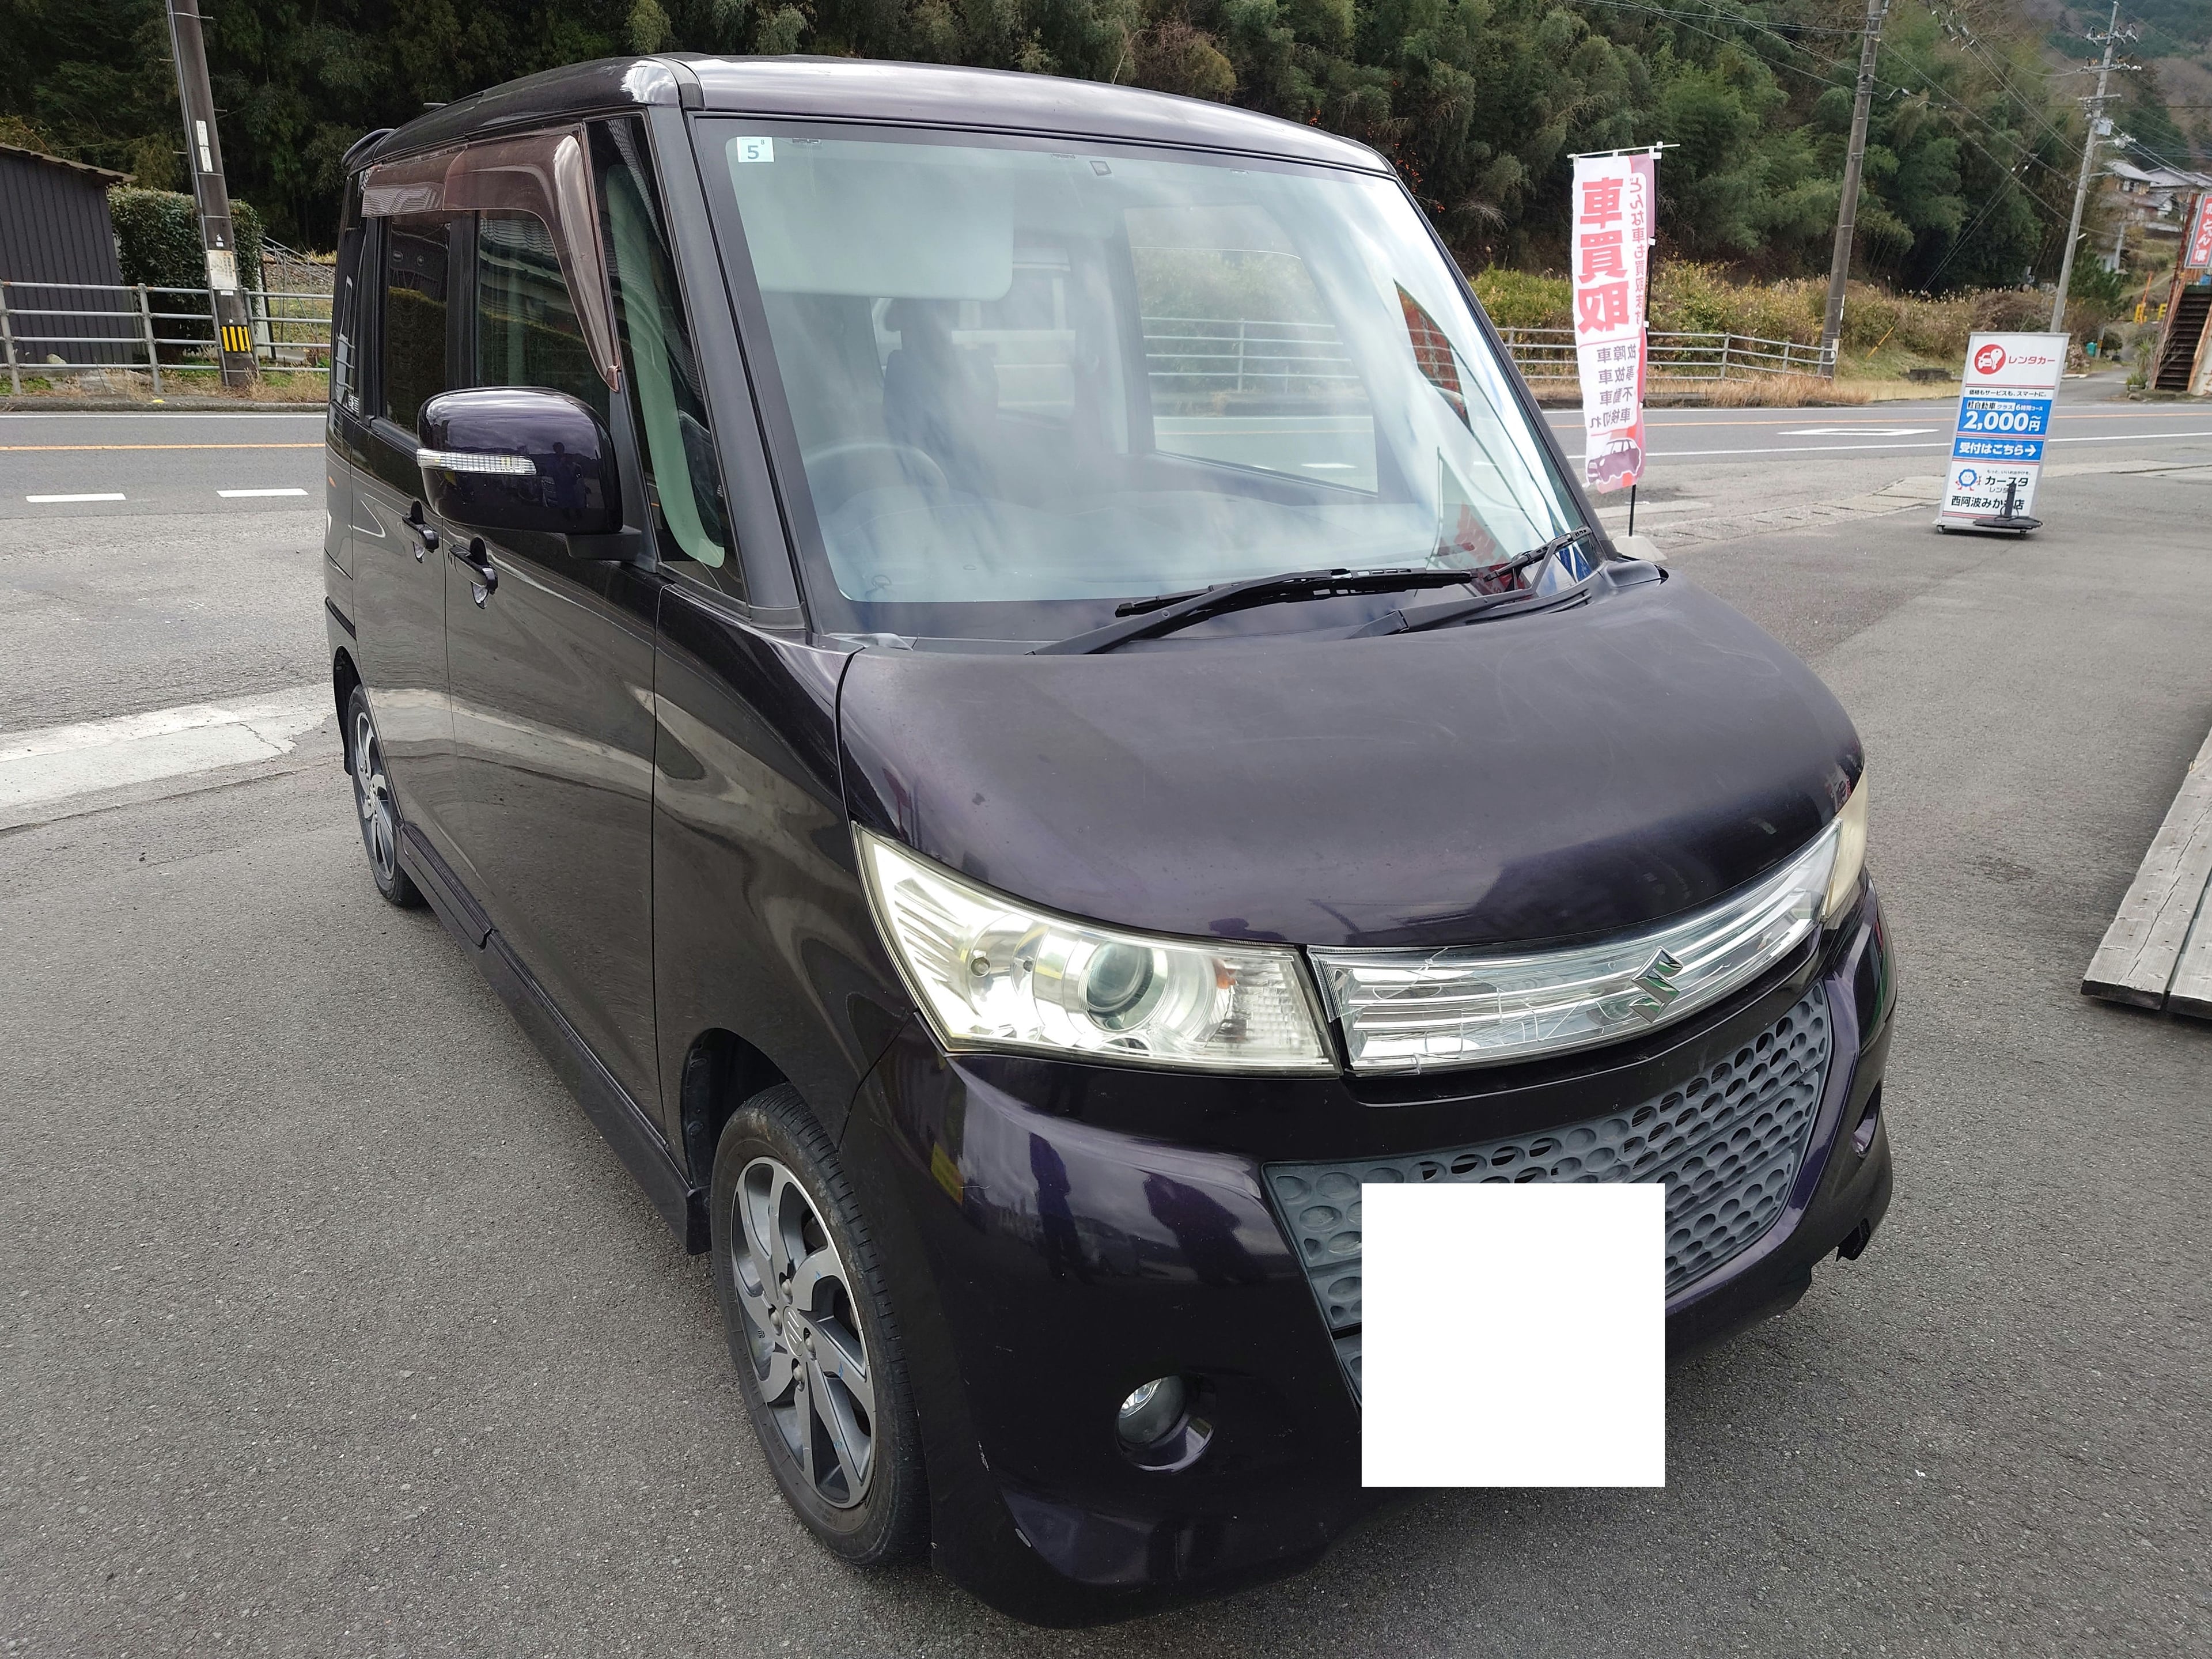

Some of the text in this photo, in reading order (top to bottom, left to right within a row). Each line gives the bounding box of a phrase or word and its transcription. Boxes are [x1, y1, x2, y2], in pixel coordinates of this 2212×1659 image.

[747, 145, 759, 160] 5
[2008, 355, 2055, 365] レンタカー
[1959, 442, 2024, 455] 受付はこちら
[1951, 495, 2025, 510] 西阿波みか店
